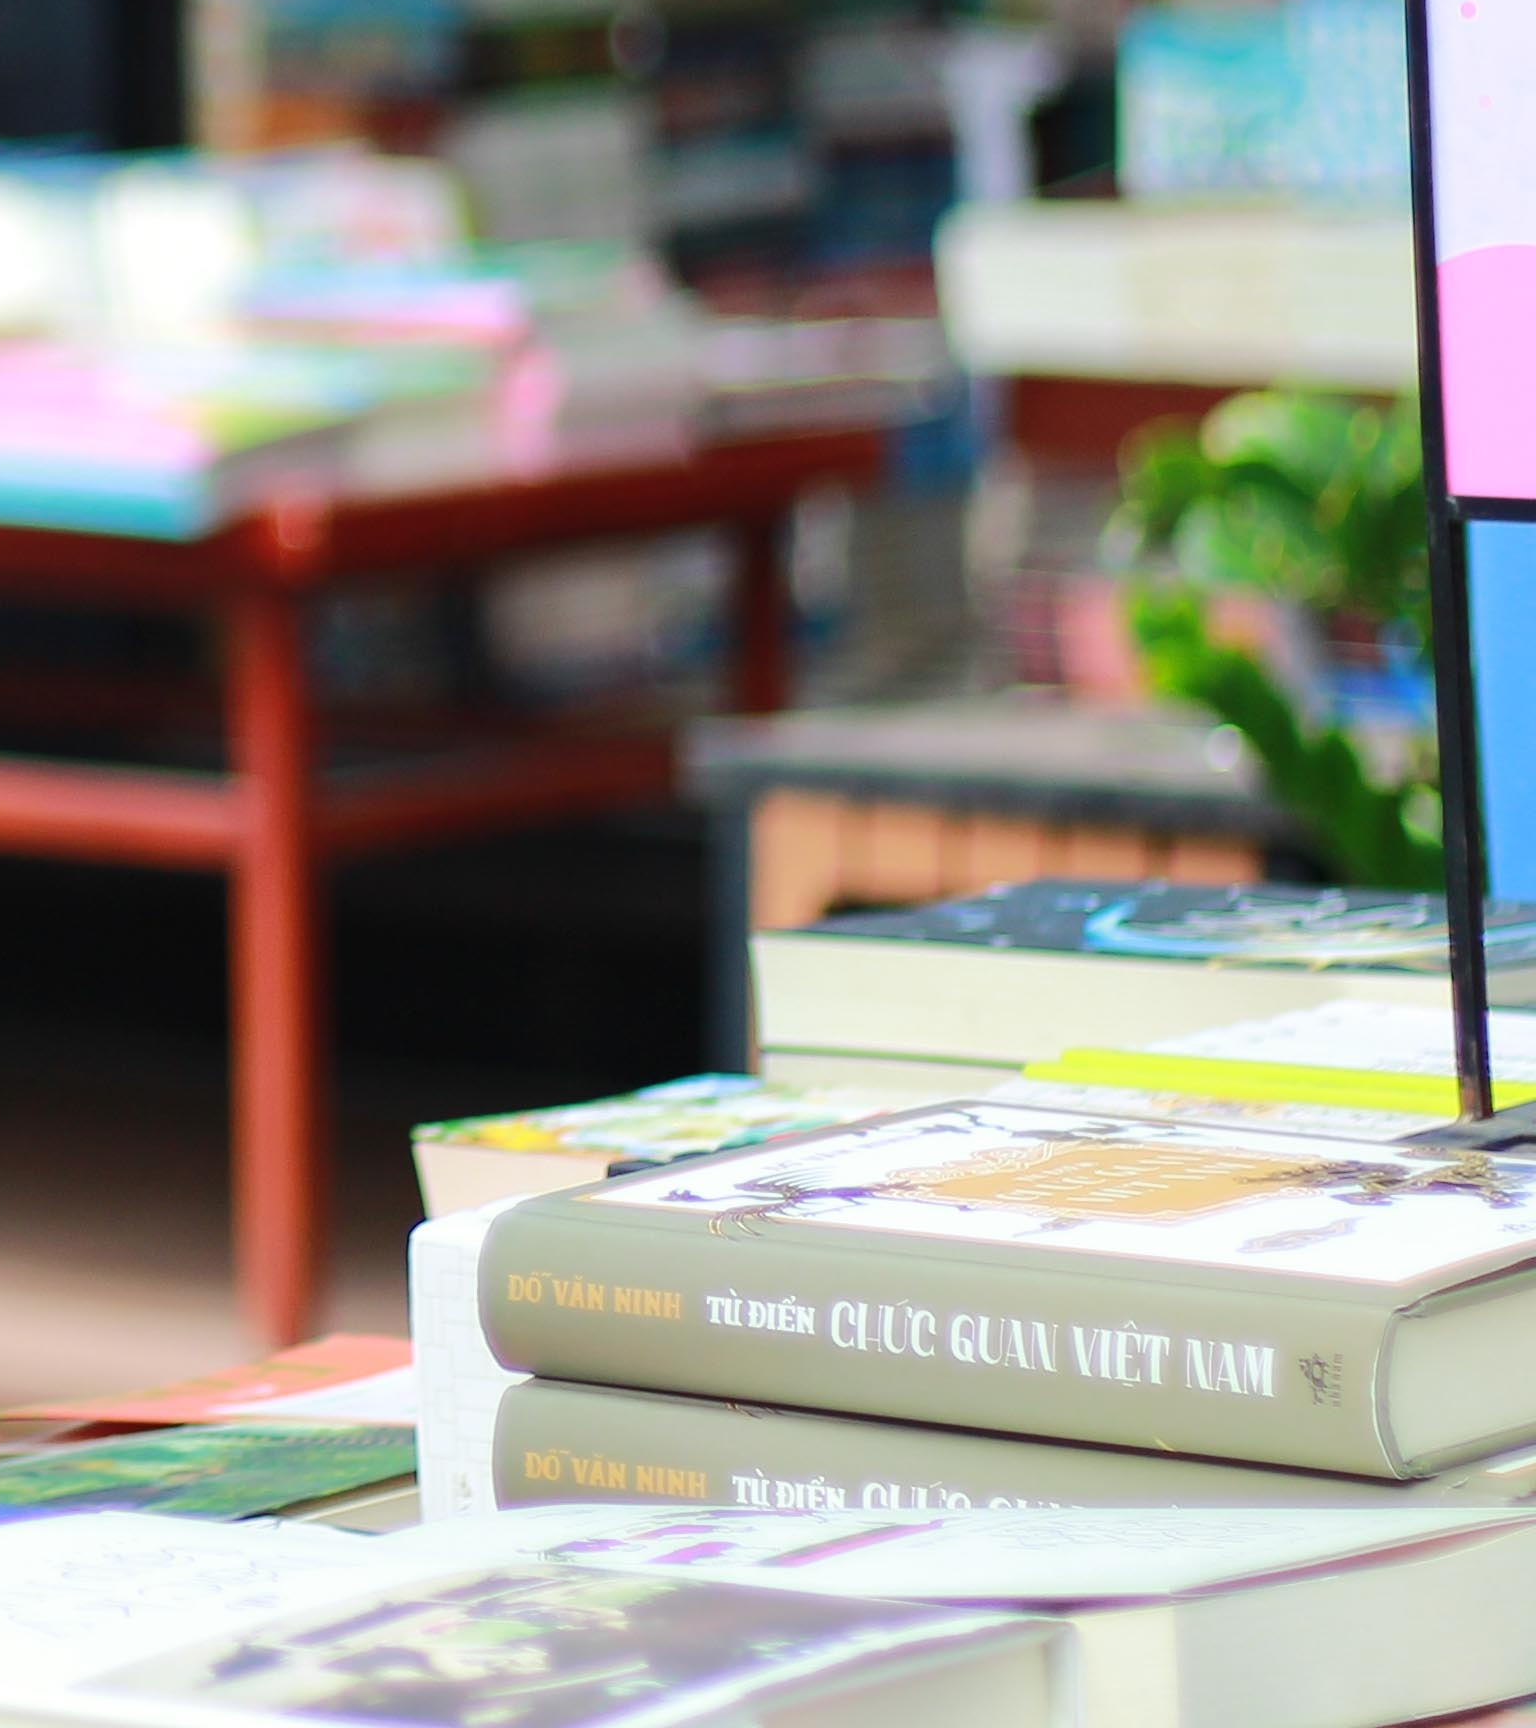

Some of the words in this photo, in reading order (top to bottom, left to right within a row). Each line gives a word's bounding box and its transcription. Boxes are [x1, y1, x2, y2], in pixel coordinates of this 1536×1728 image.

[551, 1274, 604, 1312] VĂN
[613, 1286, 682, 1320] NINH
[747, 1295, 816, 1336] ĐIỂN
[830, 1298, 938, 1359] CHỨC
[950, 1313, 1059, 1373] QUAN
[1071, 1320, 1171, 1389] VIỆT
[1184, 1338, 1276, 1399] NAM
[571, 1453, 626, 1490] VĂN
[635, 1465, 709, 1499] NINH
